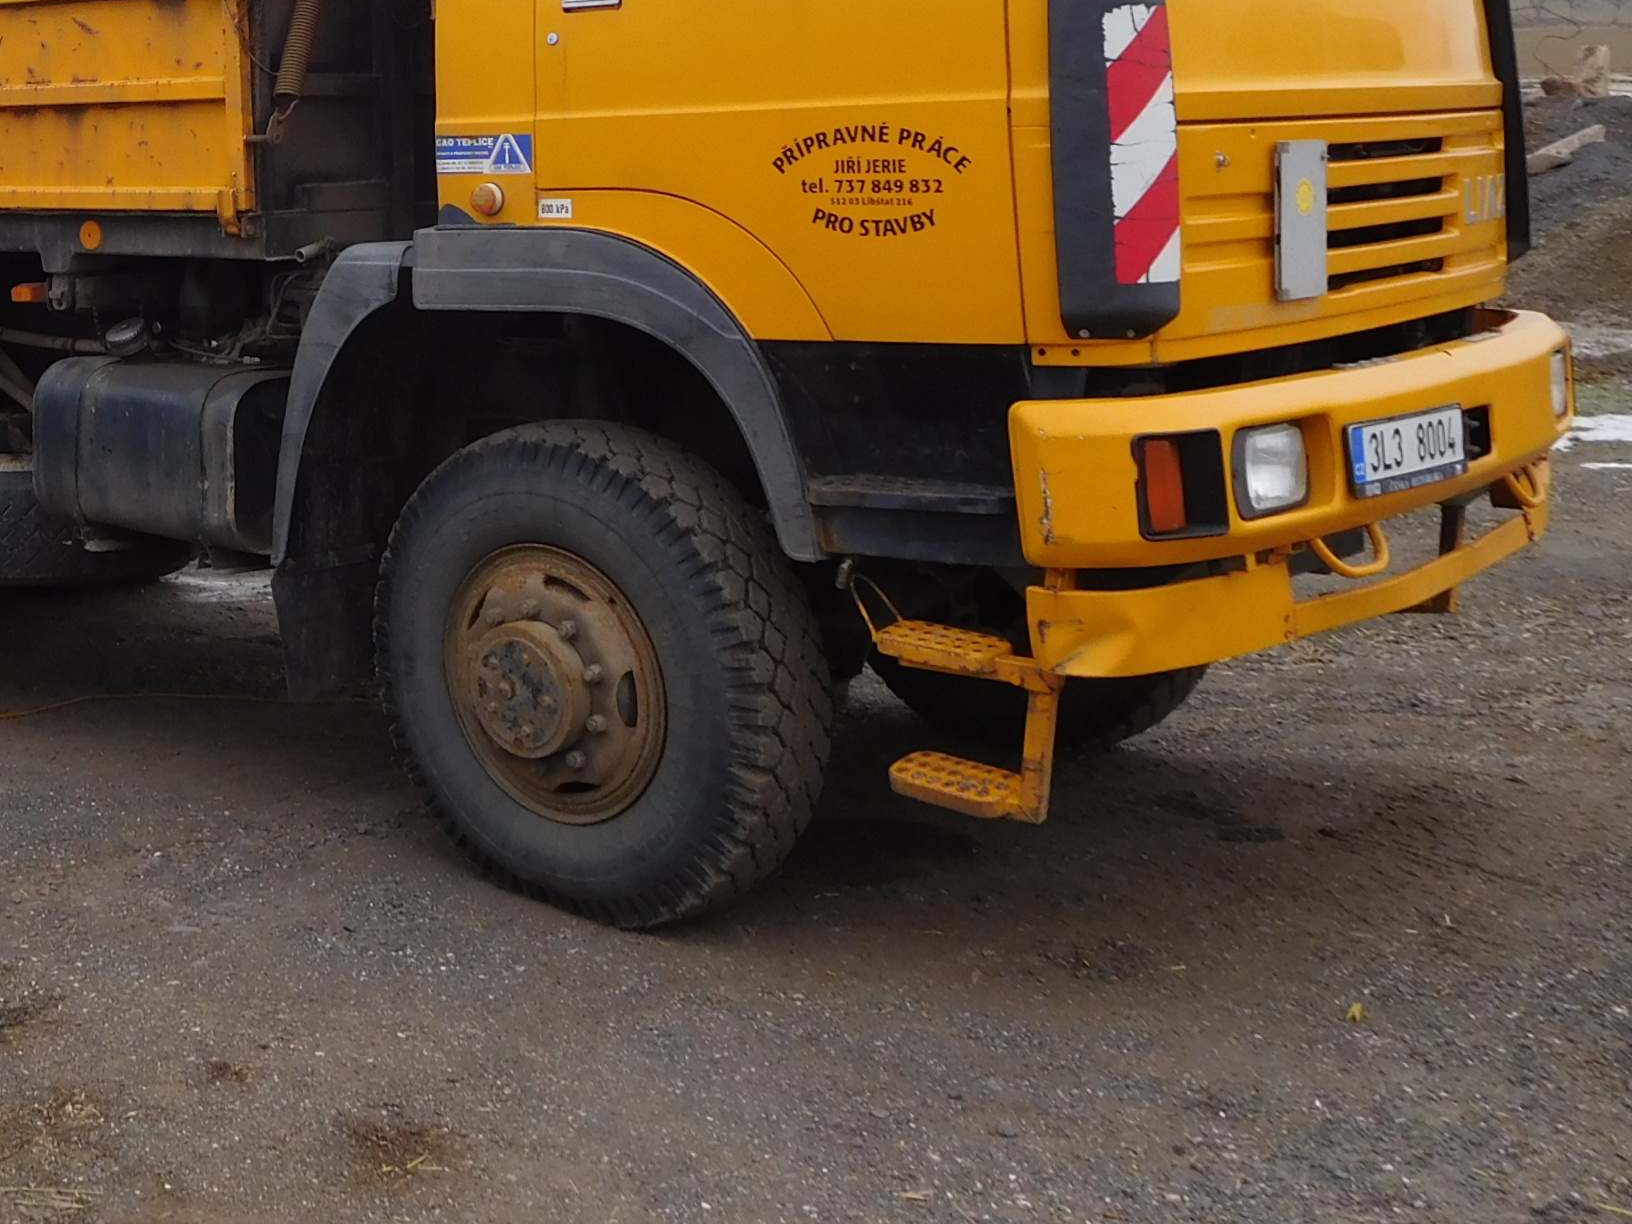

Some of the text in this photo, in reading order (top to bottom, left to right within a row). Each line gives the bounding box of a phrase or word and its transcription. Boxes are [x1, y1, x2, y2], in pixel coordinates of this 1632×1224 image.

[772, 121, 972, 175] PŘÍPRAVNÉ PRÁCE
[833, 156, 906, 175] JIŘÍ JERIE
[801, 178, 944, 194] tel. 737 849 832
[555, 203, 570, 214] kPa
[896, 197, 913, 206] 216
[811, 207, 936, 237] PRO STAVBY
[1369, 416, 1456, 473] 3L3 8004
